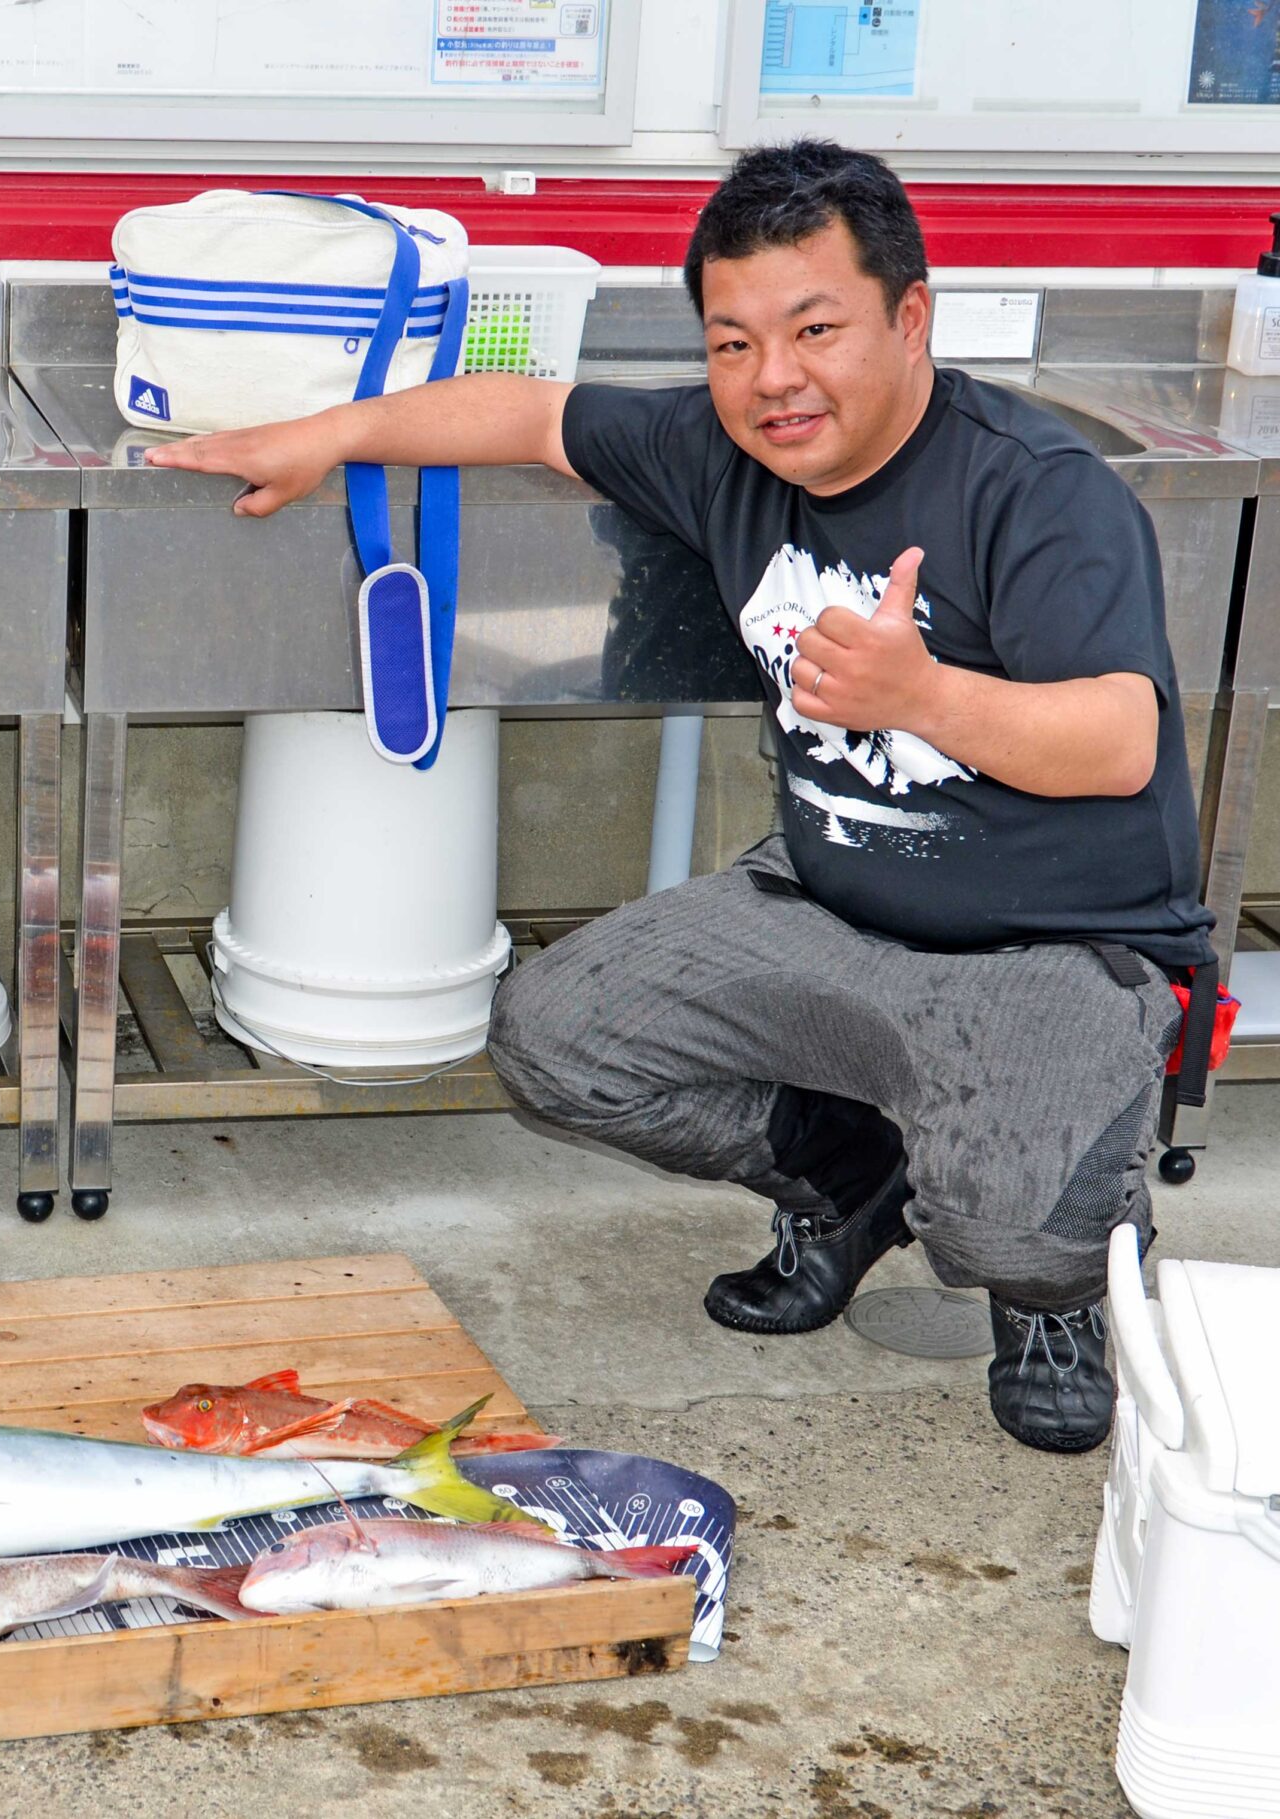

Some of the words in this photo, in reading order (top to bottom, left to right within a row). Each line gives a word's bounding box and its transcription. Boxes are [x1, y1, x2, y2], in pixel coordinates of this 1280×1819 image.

[135, 399, 160, 415] adidas
[277, 1512, 291, 1521] 60
[389, 1499, 402, 1509] 70
[498, 1486, 512, 1495] 80
[551, 1477, 565, 1488] 85
[631, 1498, 646, 1511] 95
[683, 1501, 702, 1515] 100
